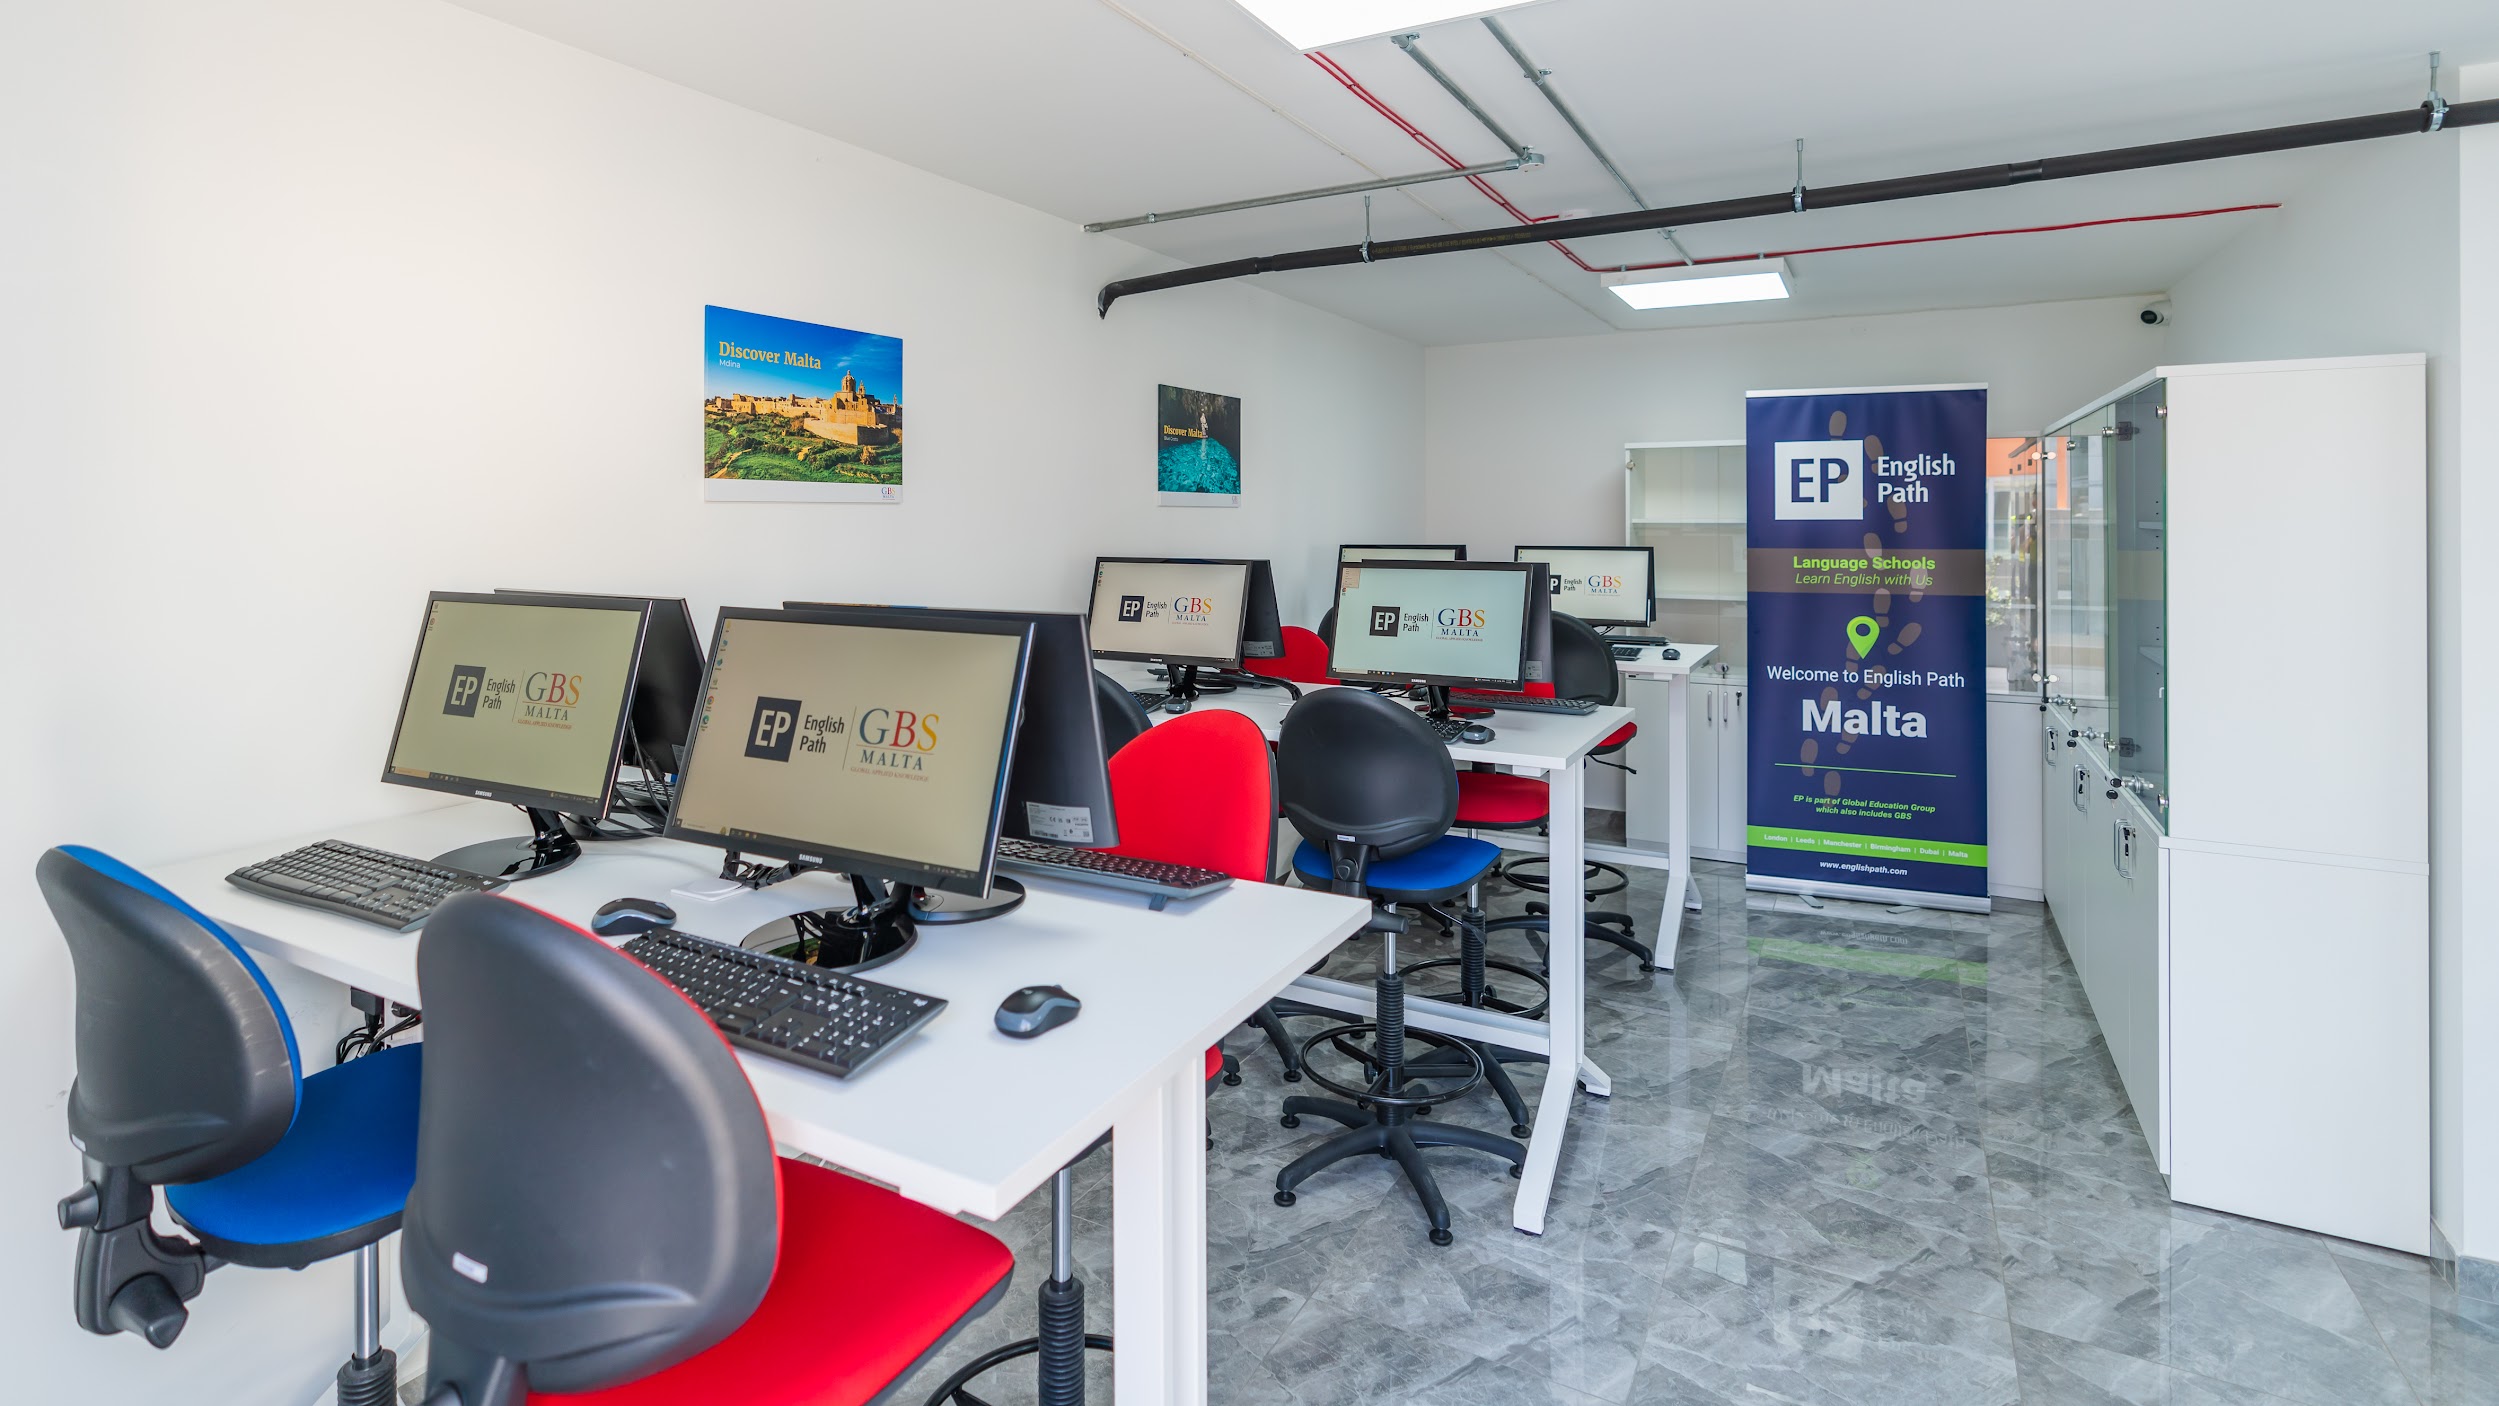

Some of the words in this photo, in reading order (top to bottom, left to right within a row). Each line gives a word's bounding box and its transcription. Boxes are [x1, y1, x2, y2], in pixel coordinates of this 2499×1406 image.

[719, 341, 780, 364] Discover
[784, 351, 822, 370] Malta
[719, 358, 740, 368] Mdina
[1164, 424, 1187, 436] Discover
[1188, 428, 1202, 438] Malta
[1877, 453, 1956, 482] English
[1790, 458, 1850, 504] EP
[1877, 482, 1929, 503] Path
[1793, 556, 1868, 572] Language
[1872, 556, 1936, 570] Schools
[1564, 578, 1582, 586] English
[1588, 575, 1622, 588] GBS
[1795, 573, 1830, 585] Learn
[1834, 573, 1880, 587] English
[1884, 574, 1912, 586] with
[1915, 574, 1934, 586] Us
[1122, 600, 1141, 617] EP
[1146, 602, 1168, 610] English
[1146, 610, 1160, 618] Path
[1174, 596, 1212, 614] GBS
[1176, 614, 1206, 622] MALTA
[1374, 612, 1396, 630] EP
[1404, 613, 1428, 624] English
[1438, 608, 1485, 628] GBS
[1402, 624, 1420, 632] Path
[1440, 628, 1479, 637] MALTA
[486, 678, 516, 696] English
[1767, 666, 1839, 682] Welcome
[1842, 668, 1859, 684] to
[1863, 670, 1922, 690] English
[1927, 672, 1965, 688] Path
[450, 675, 478, 706] EP
[526, 671, 582, 706] GBS
[482, 696, 502, 710] Path
[525, 706, 568, 721] MALTA
[1802, 698, 1928, 738] Malta
[754, 709, 792, 748] EP
[804, 714, 845, 736] English
[859, 708, 940, 752] GBS
[800, 736, 827, 754] Path
[860, 750, 923, 771] MALTA
[1793, 795, 1805, 803] EP
[1806, 796, 1813, 804] is
[1814, 796, 1830, 806] part
[1832, 797, 1840, 806] of
[1842, 798, 1868, 807] Global
[1869, 800, 1909, 810] Education
[1910, 803, 1936, 814] Group
[1815, 806, 1840, 816] which
[1840, 807, 1857, 816] also
[1858, 808, 1892, 819] includes
[1894, 811, 1912, 820] GBS
[1764, 834, 1788, 842] London
[1796, 836, 1816, 844] Leeds
[1823, 838, 1862, 849] Manchester
[1870, 843, 1911, 854] Birmingham
[1920, 847, 1940, 856] Dubai
[1948, 850, 1968, 858] Malta
[798, 854, 823, 864] SAMSUNG
[1820, 860, 1908, 876] www.englishpath.com
